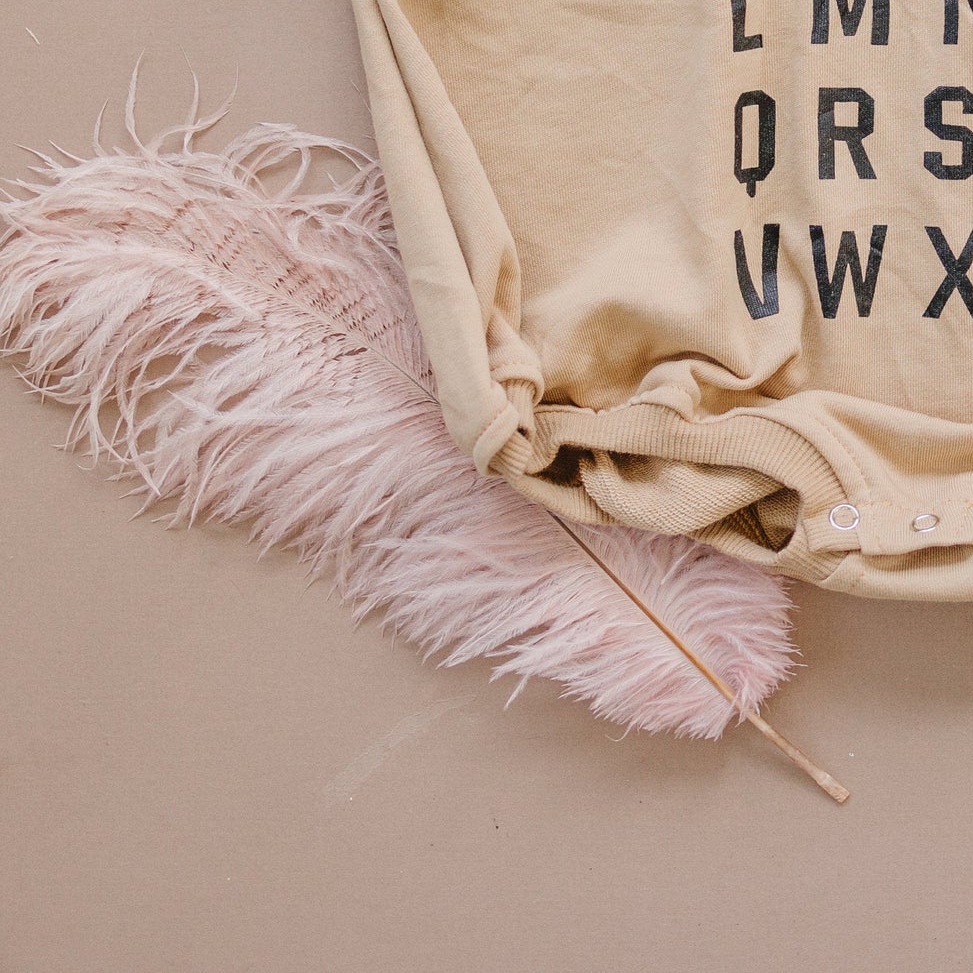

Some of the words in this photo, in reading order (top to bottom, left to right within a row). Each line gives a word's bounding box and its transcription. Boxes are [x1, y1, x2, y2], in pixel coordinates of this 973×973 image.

[733, 89, 777, 199] Q
[817, 87, 877, 180] R
[733, 223, 781, 321] V
[808, 224, 888, 320] W
